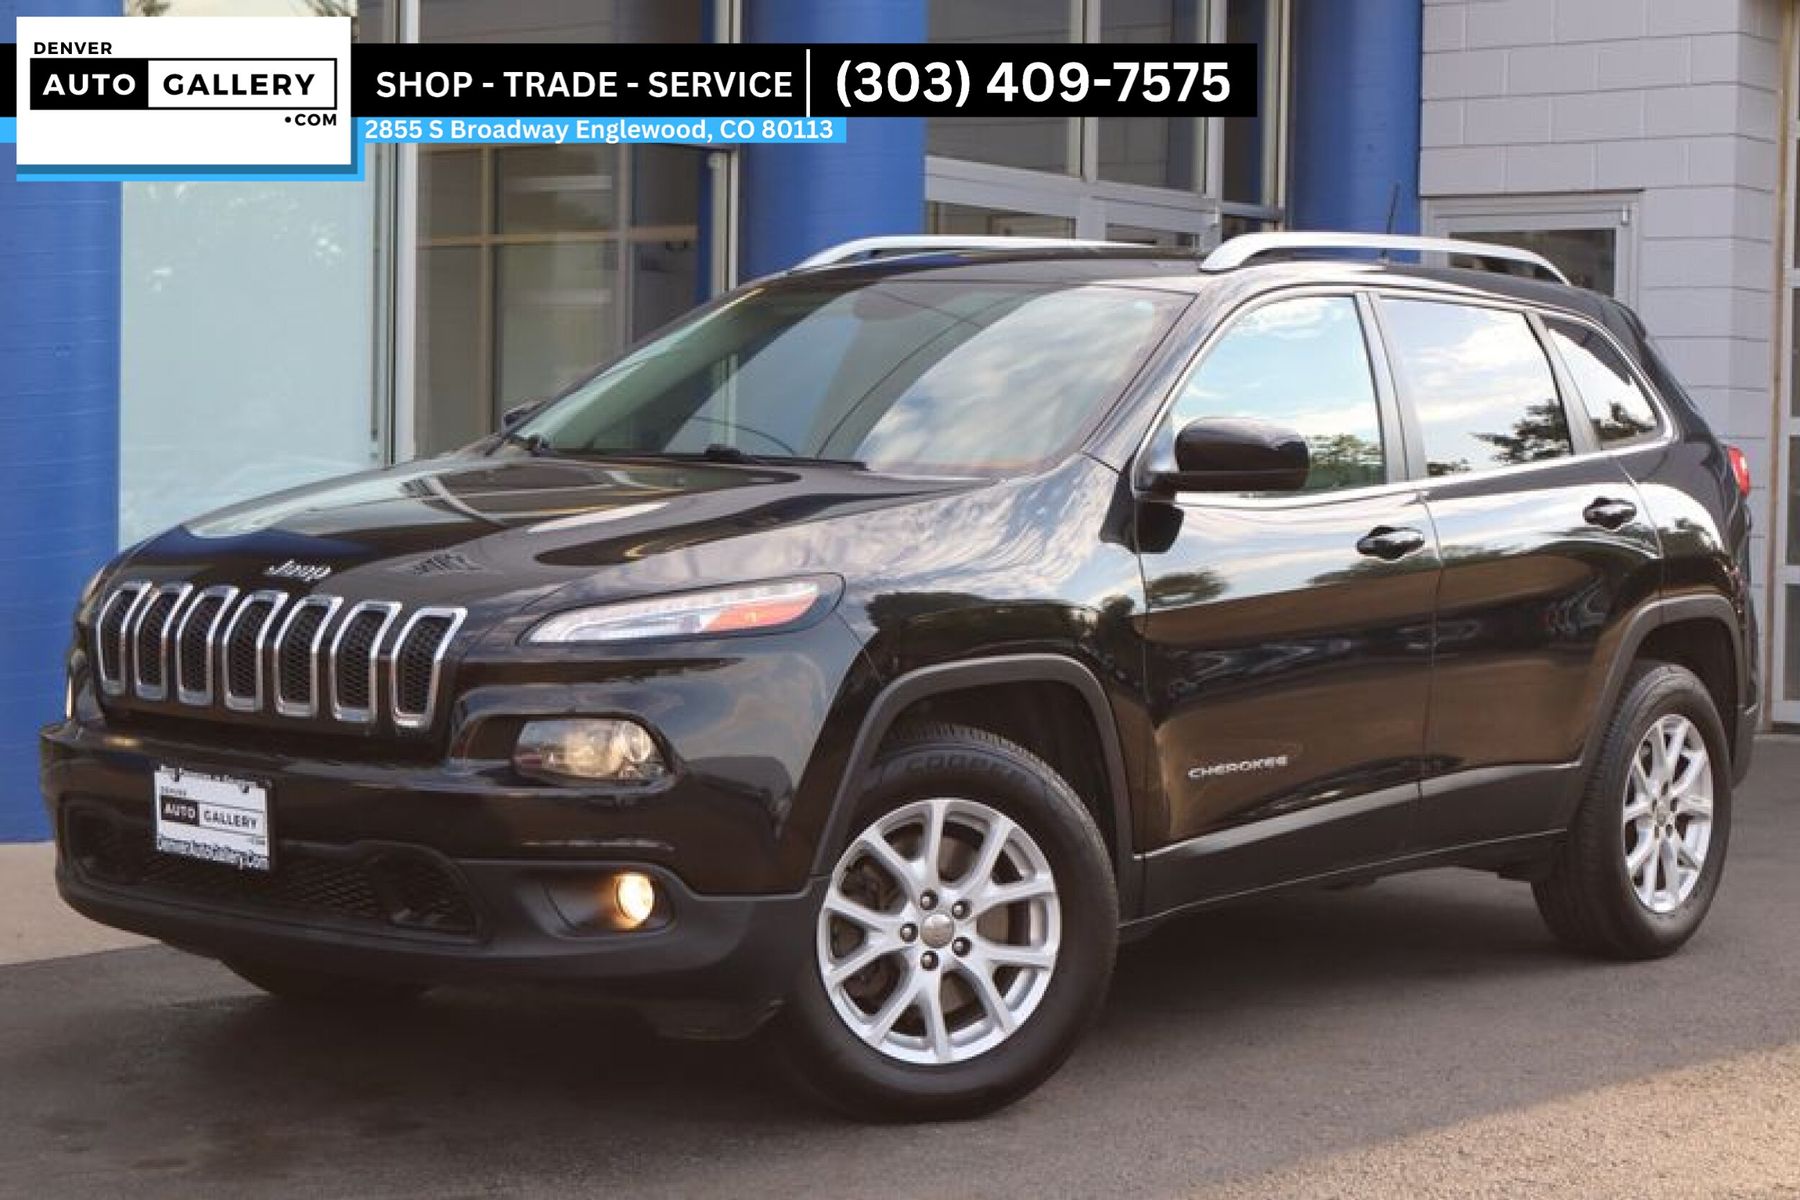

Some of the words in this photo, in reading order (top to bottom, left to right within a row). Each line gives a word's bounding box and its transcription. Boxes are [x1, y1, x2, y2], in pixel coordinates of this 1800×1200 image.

[1187, 755, 1288, 779] CHEROKEE
[164, 802, 197, 820] AUTO
[203, 809, 257, 829] GALLERY
